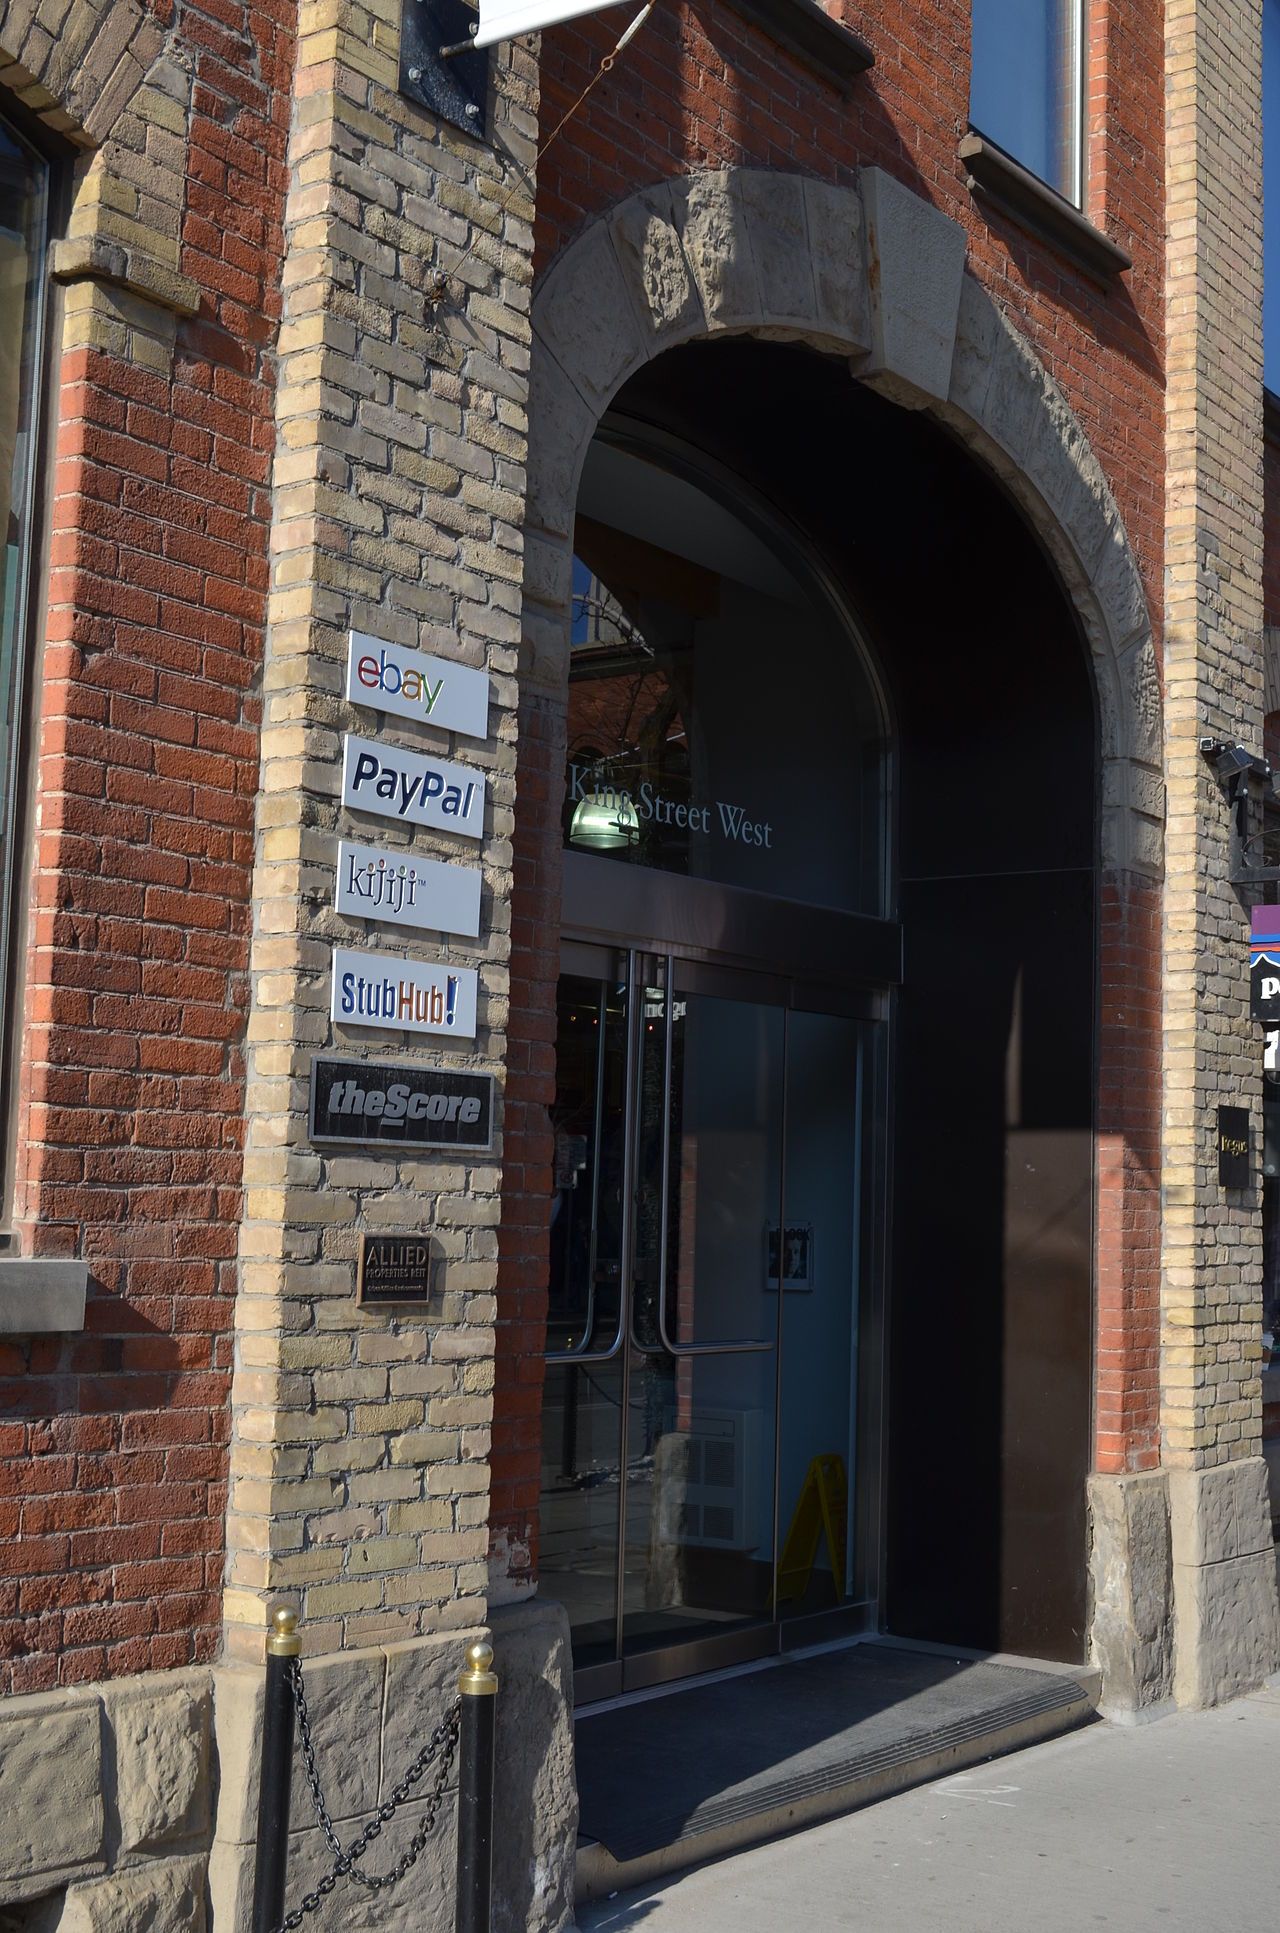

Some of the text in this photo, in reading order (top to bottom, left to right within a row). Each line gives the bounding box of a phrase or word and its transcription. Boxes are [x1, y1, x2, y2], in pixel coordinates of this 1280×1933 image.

[358, 650, 444, 714] ebay
[352, 752, 476, 818] PayPal
[569, 763, 773, 848] King Street West
[346, 854, 417, 914] kijiji
[341, 972, 459, 1026] StubHub!
[328, 1080, 482, 1125] theScore
[365, 1267, 409, 1279] PROPERTIES
[366, 1246, 427, 1266] ALLIED
